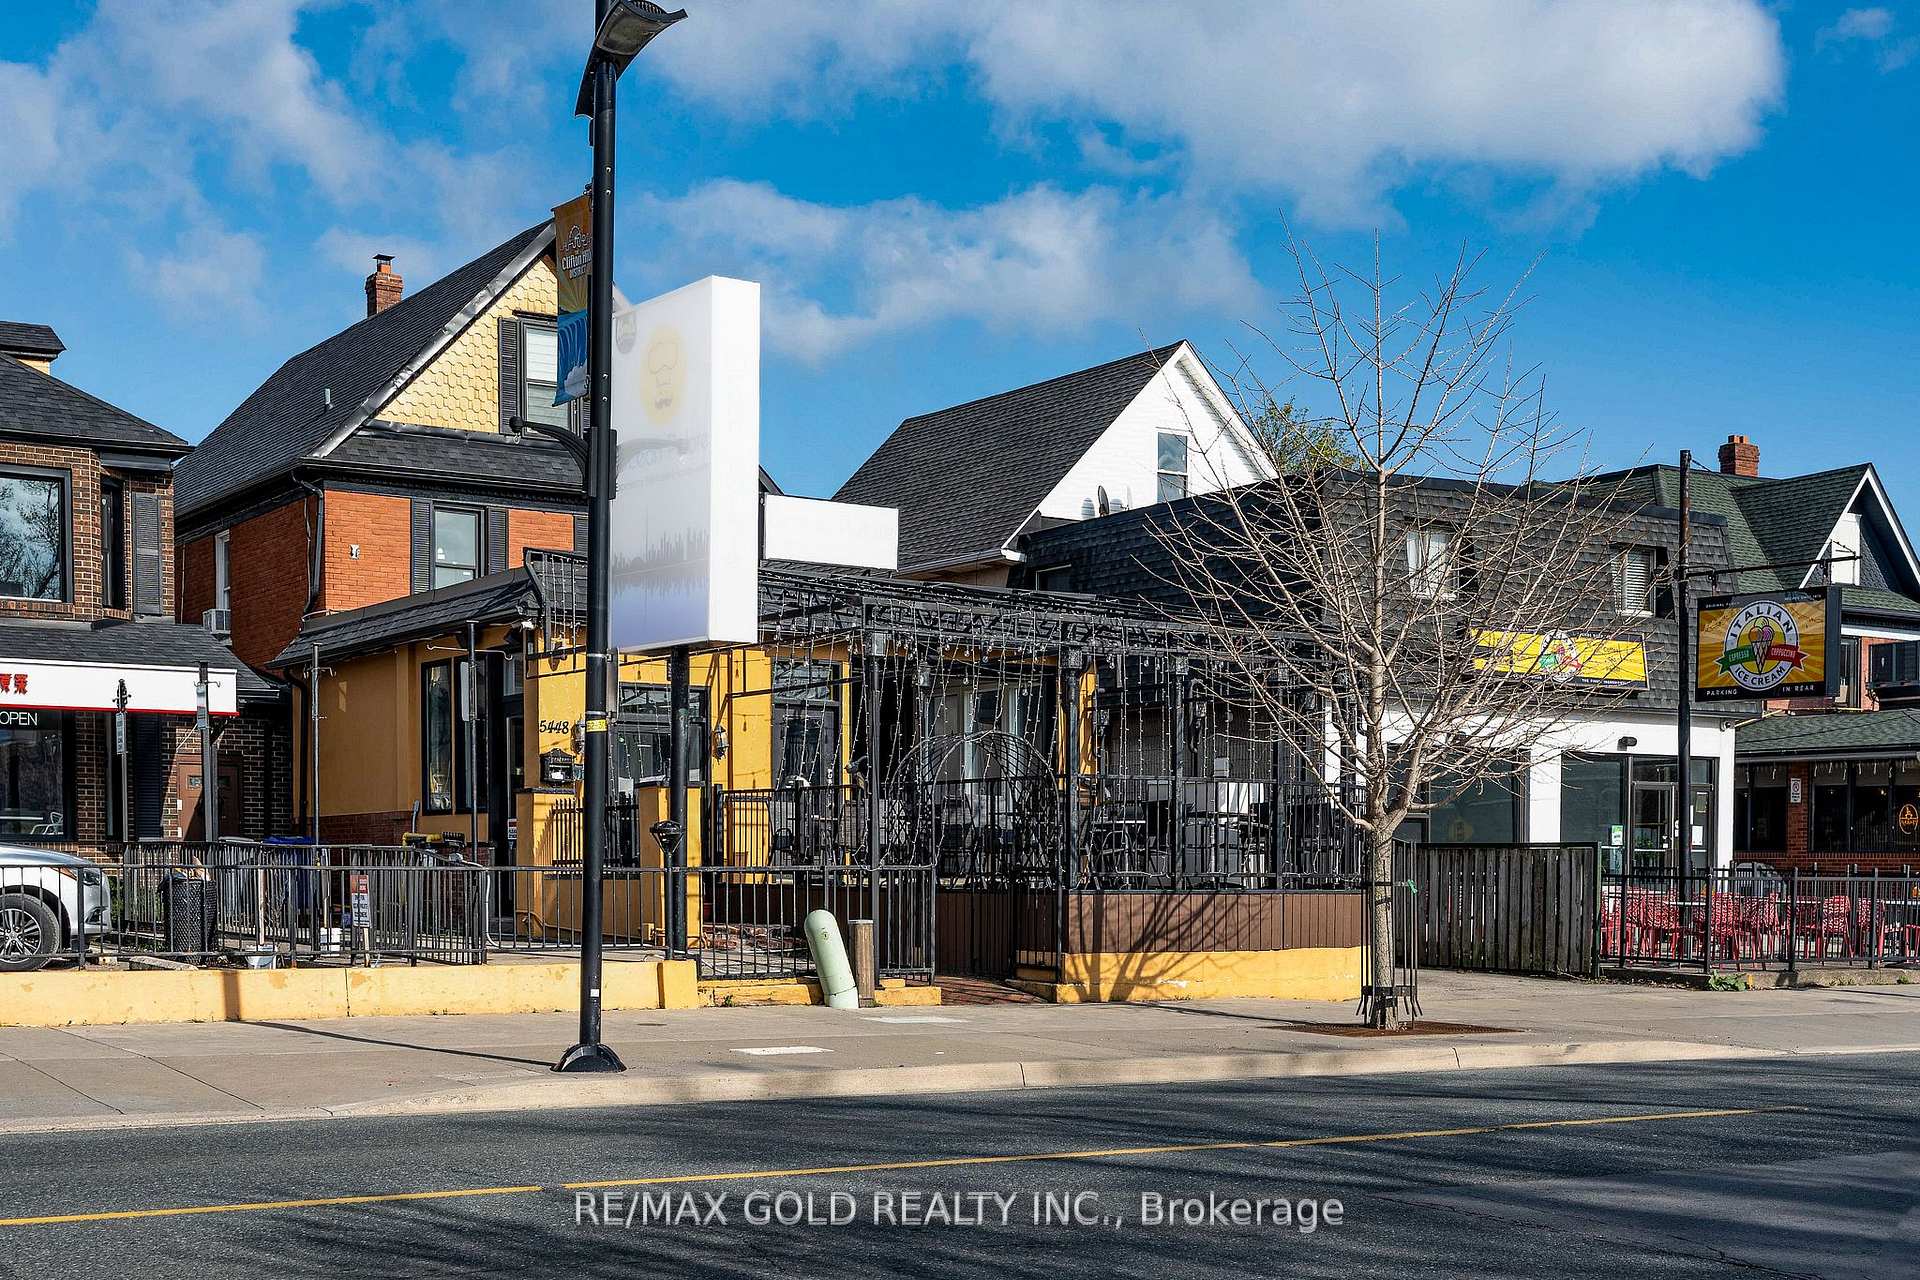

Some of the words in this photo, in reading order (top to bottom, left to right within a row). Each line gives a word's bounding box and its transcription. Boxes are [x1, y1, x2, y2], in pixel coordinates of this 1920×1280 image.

[1729, 605, 1793, 638] ITALIAN
[1734, 667, 1750, 683] ICE
[1750, 666, 1786, 686] CREAM
[1706, 688, 1738, 696] PARKING
[1794, 684, 1815, 692] REAR
[0, 710, 38, 726] OPEN
[539, 719, 569, 735] 5448
